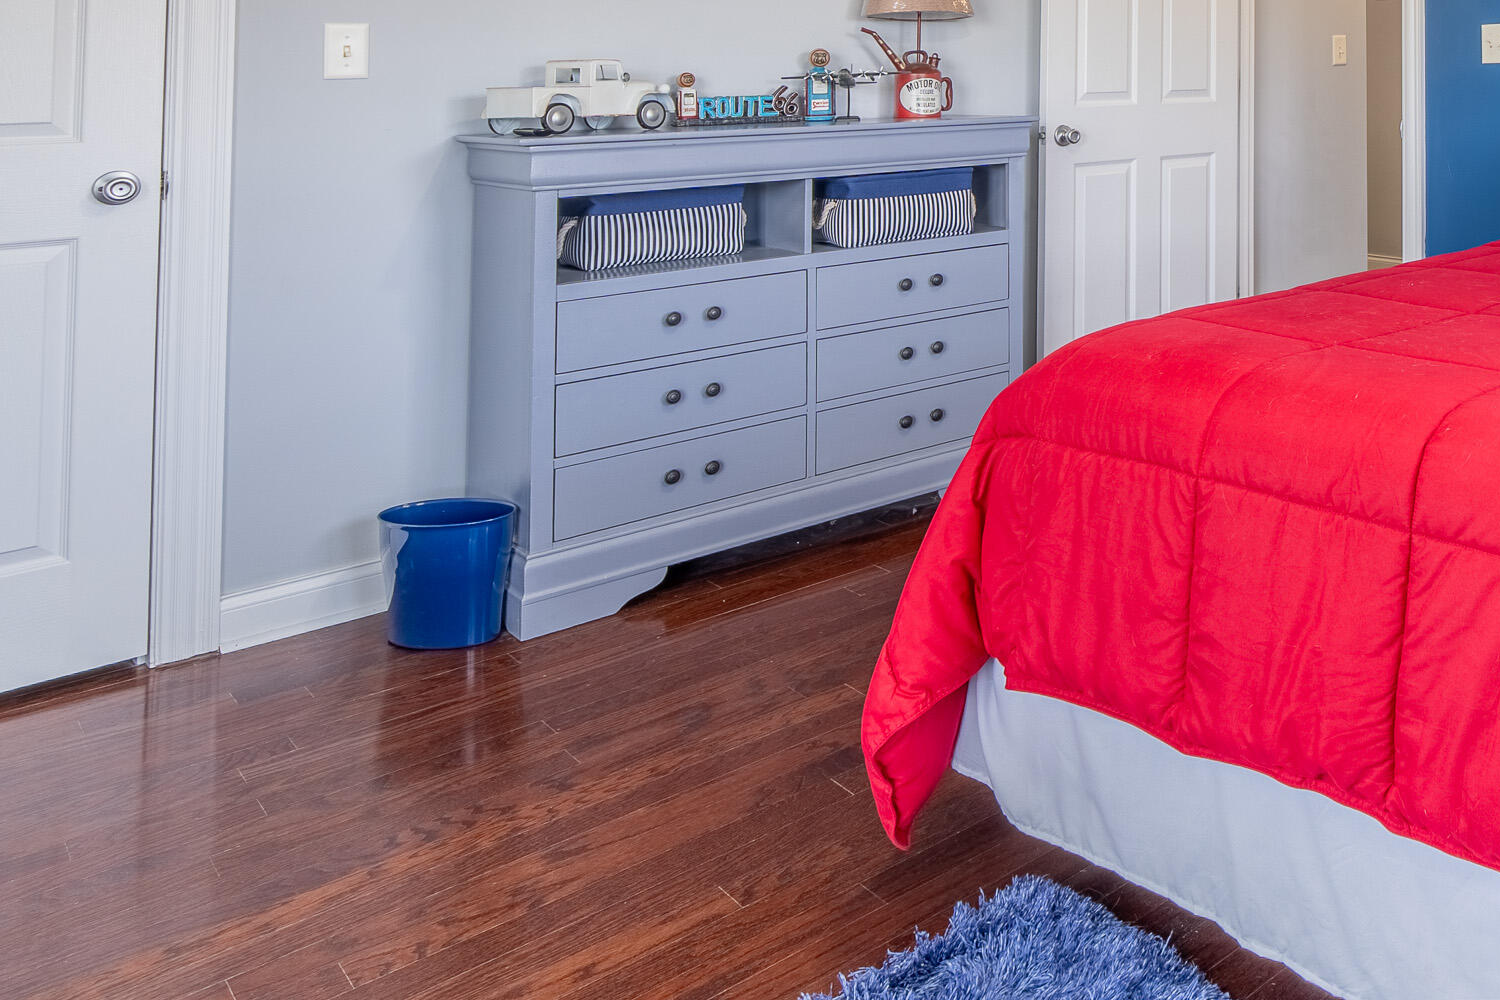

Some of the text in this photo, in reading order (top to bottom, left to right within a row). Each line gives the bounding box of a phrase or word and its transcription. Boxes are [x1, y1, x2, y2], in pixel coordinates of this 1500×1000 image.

[906, 79, 934, 93] MOTOR
[698, 95, 780, 119] ROUTE
[771, 85, 799, 117] 66
